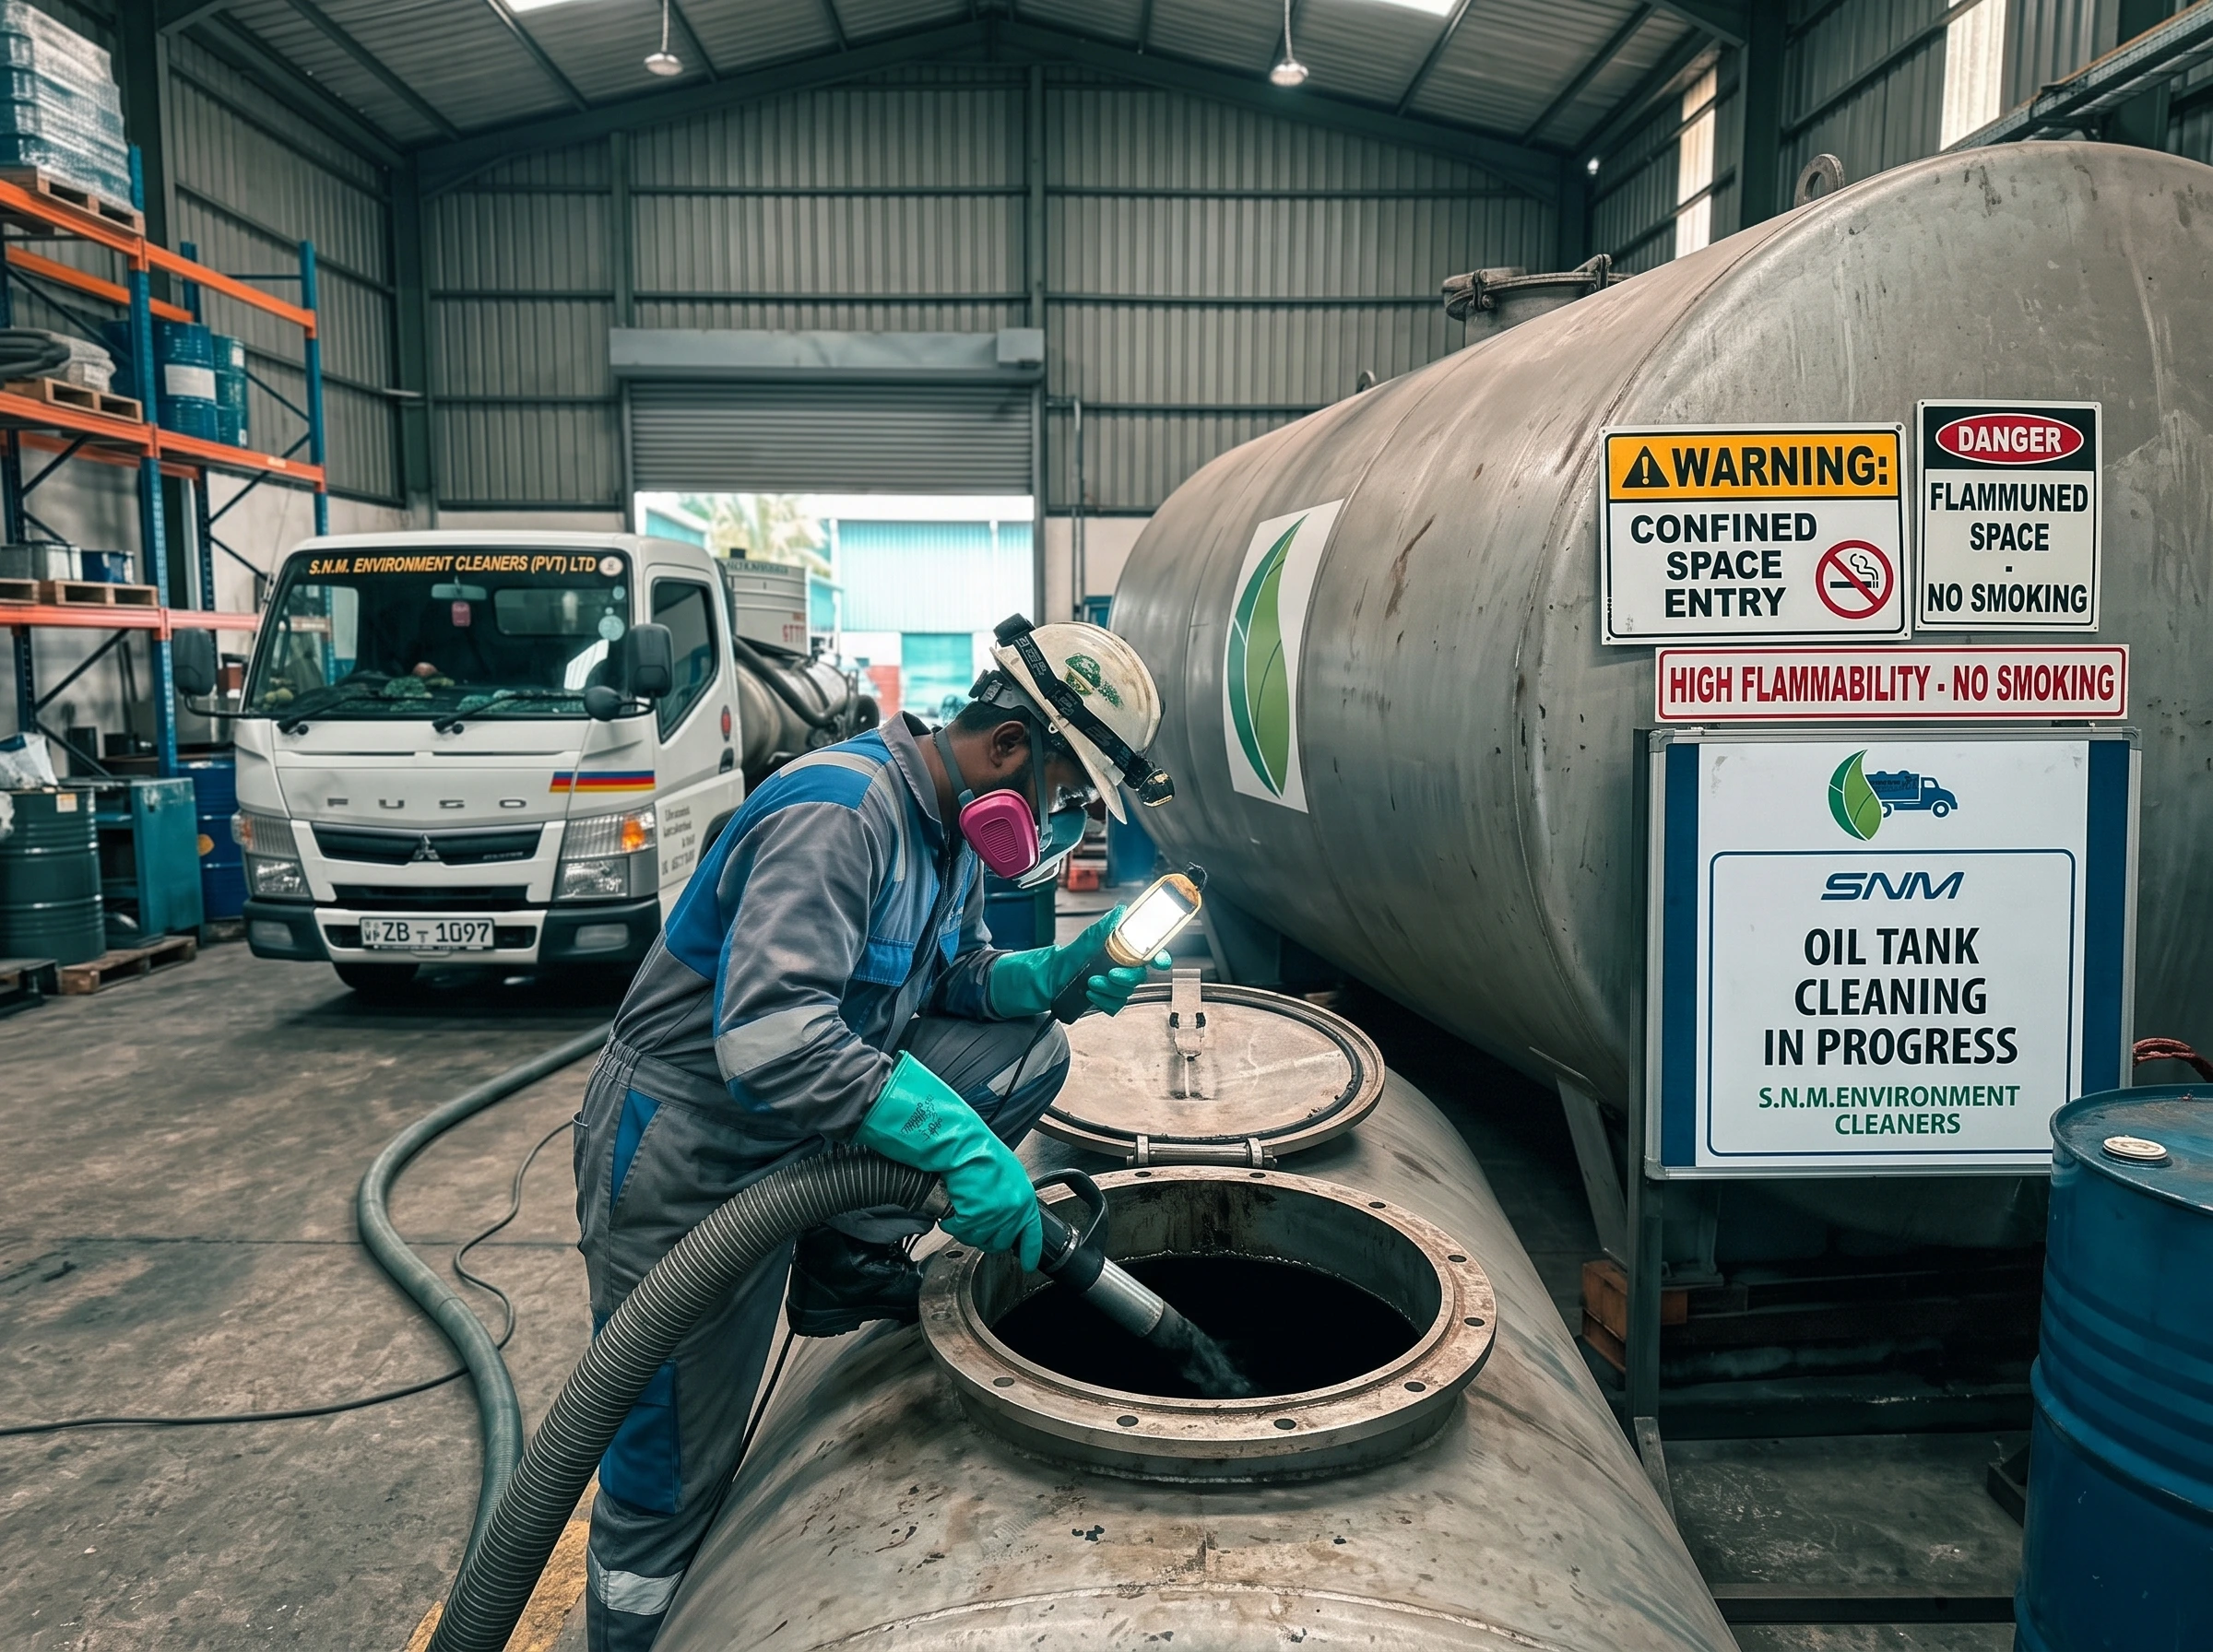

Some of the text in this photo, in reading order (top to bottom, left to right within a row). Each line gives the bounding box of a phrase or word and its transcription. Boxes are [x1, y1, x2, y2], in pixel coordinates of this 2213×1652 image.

[1958, 426, 2063, 453] DANGER
[1672, 446, 1888, 488] WARNING:
[1931, 483, 2089, 513] FLAMMUNED
[1631, 513, 1817, 544] CONFINED
[1970, 523, 2050, 551] SPACE
[309, 555, 597, 575] S.N.M. ENVIRONMENT CLEANERS (PVT) LTD
[1667, 550, 1782, 581] SPACE
[1665, 587, 1787, 619] ENTRY
[1928, 584, 2088, 614] NO SMOKING
[1671, 667, 1733, 703] HIGH
[1743, 666, 1932, 702] FLAMMABILITY
[1954, 665, 1989, 702] NO
[1997, 665, 2114, 702] SMOKING
[1821, 872, 1965, 901] SNM
[382, 922, 410, 942] ZB
[436, 922, 490, 942] 1097
[1805, 927, 1980, 966] OIL TANK
[1795, 978, 1987, 1016] CLEANING
[1765, 1027, 2018, 1066] IN PROGRESS
[1759, 1086, 2021, 1109] S.N.M.ENVIRONMENT
[1836, 1114, 1961, 1135] CLEANERS
